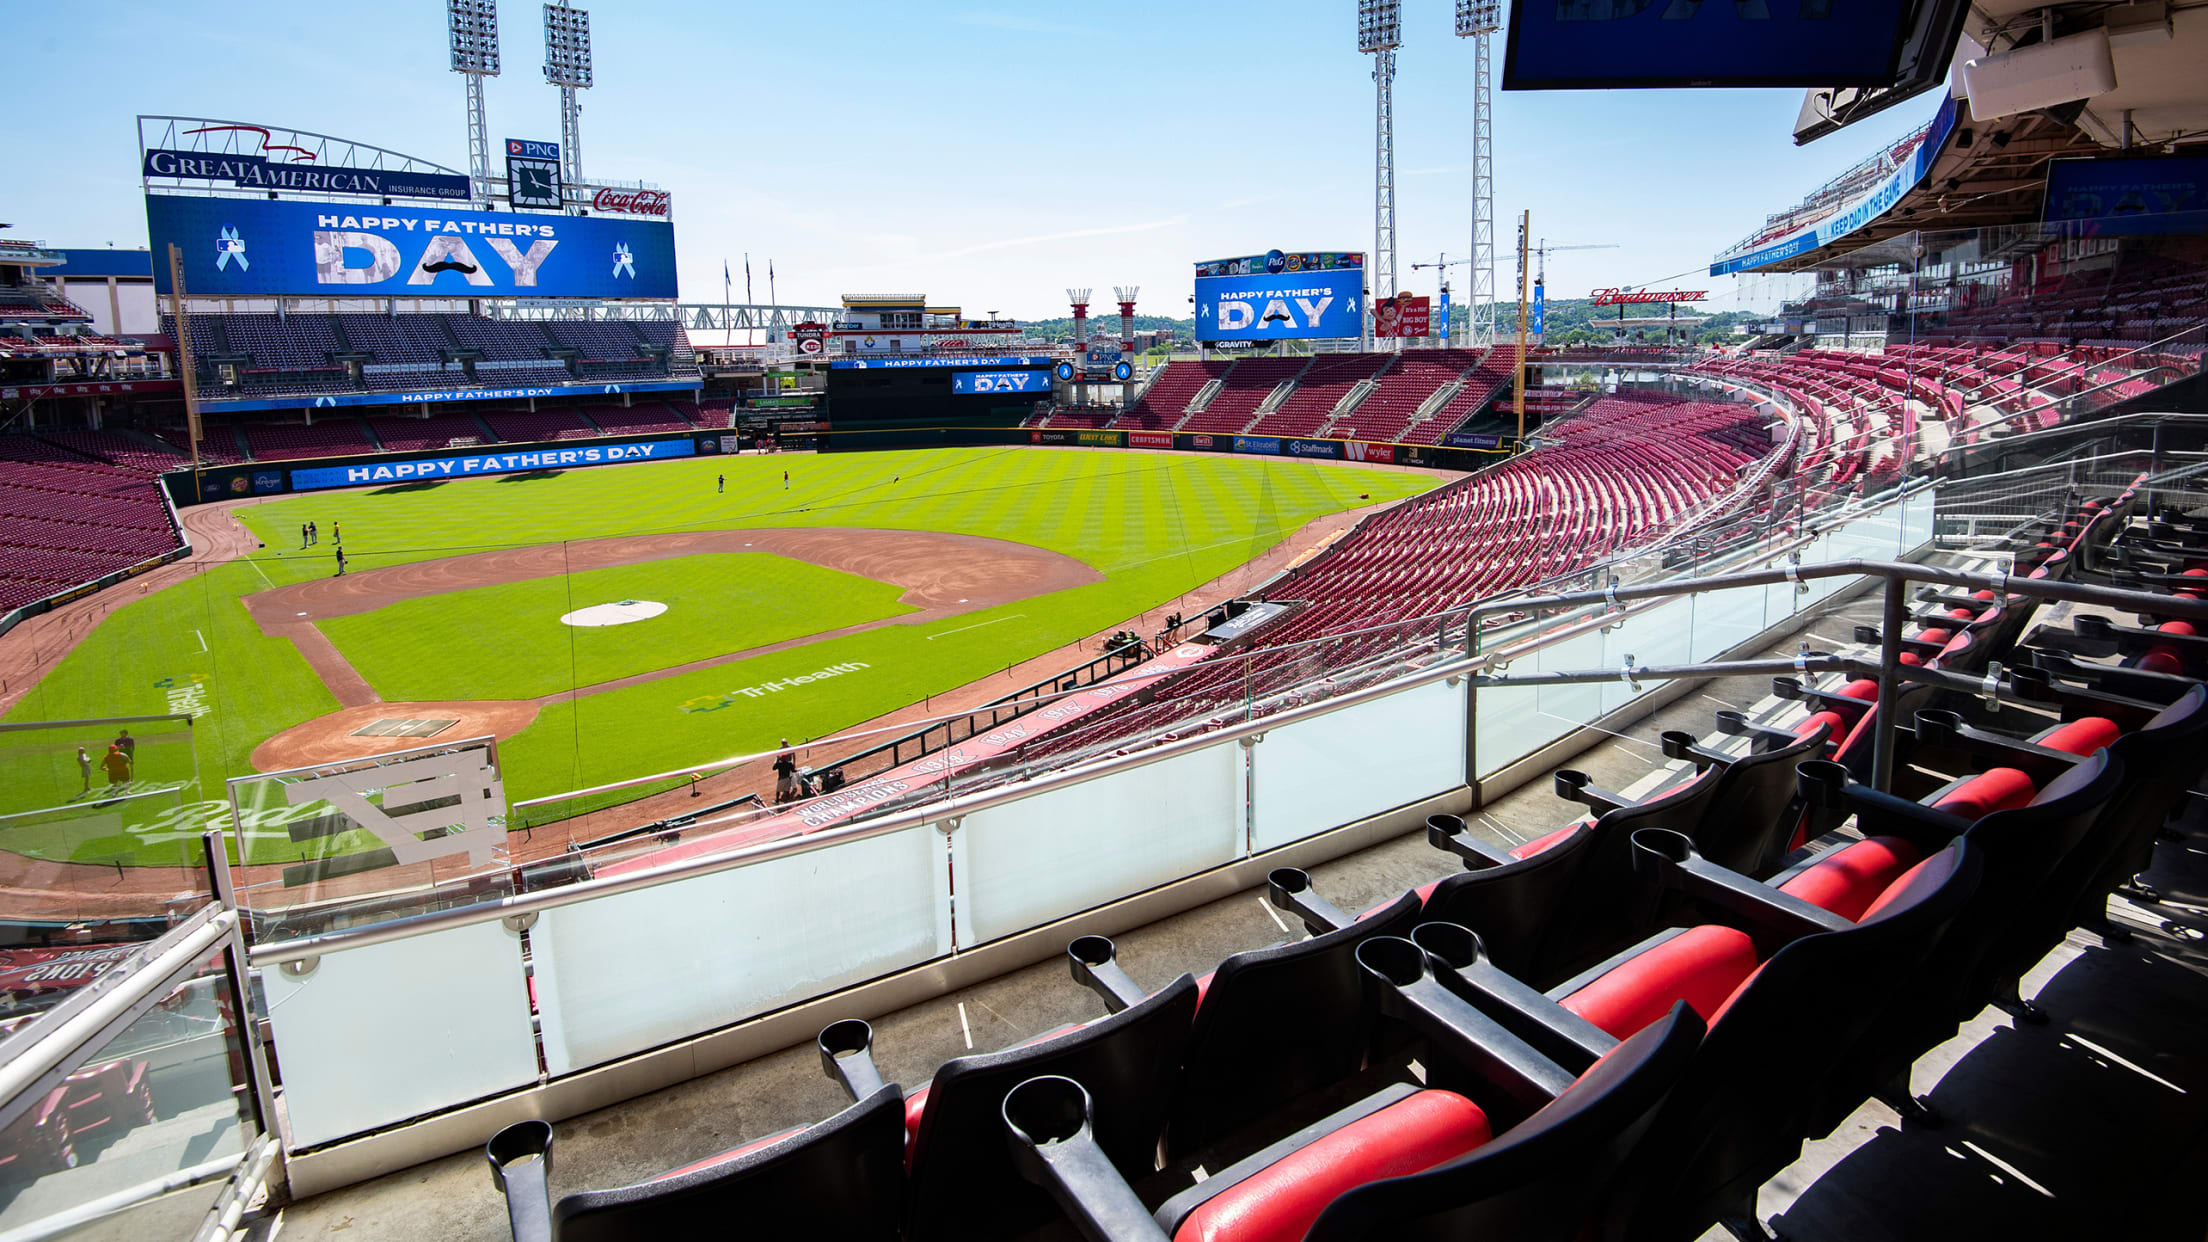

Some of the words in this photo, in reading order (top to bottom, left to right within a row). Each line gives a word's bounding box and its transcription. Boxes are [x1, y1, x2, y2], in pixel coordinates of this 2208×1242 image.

[525, 142, 558, 157] PNC
[388, 185, 436, 195] INSURANCE
[439, 187, 466, 197] GROUP
[2068, 184, 2118, 193] HAPPY
[593, 187, 671, 216] Coca-Cola
[1830, 217, 1849, 237] KEEP
[1849, 211, 1862, 231] DAD
[1862, 206, 1870, 224] IN
[1869, 195, 1883, 220] THE
[1883, 175, 1900, 208] GAME
[318, 214, 418, 231] HAPPY
[425, 220, 555, 237] FATHER'S
[314, 230, 559, 287] DAY
[1268, 257, 1284, 267] P&G
[1741, 255, 1761, 267] HAPPY
[1761, 247, 1789, 263] FATHER'S
[1221, 291, 1264, 300] HAPPY
[1266, 288, 1332, 299] FATHER'S
[1591, 287, 1705, 306] Budweiser
[1218, 296, 1334, 331] DAY
[1219, 341, 1252, 349] GRAVITY
[885, 359, 923, 367] HAPPY
[925, 358, 979, 367] FATHER'S
[981, 358, 1001, 366] DAY
[974, 377, 1029, 392] DAY
[402, 391, 451, 402] HAPPY
[455, 388, 525, 400] FATHER'S
[528, 387, 553, 396] DAY
[1131, 436, 1171, 445] CRAFTSMAN
[1453, 437, 1474, 445] planet
[1475, 437, 1496, 445] fitness
[1301, 444, 1333, 454] Staffmark
[1369, 449, 1392, 459] wyler
[348, 460, 456, 482] HAPPY
[463, 449, 601, 473] FATHER'S
[608, 444, 655, 459] DAY
[732, 661, 871, 698] TriHealth
[1046, 704, 1080, 721] 1975
[987, 728, 1026, 746] 1940
[794, 791, 843, 818] WORLD
[803, 781, 911, 828] CHAMPIONS
